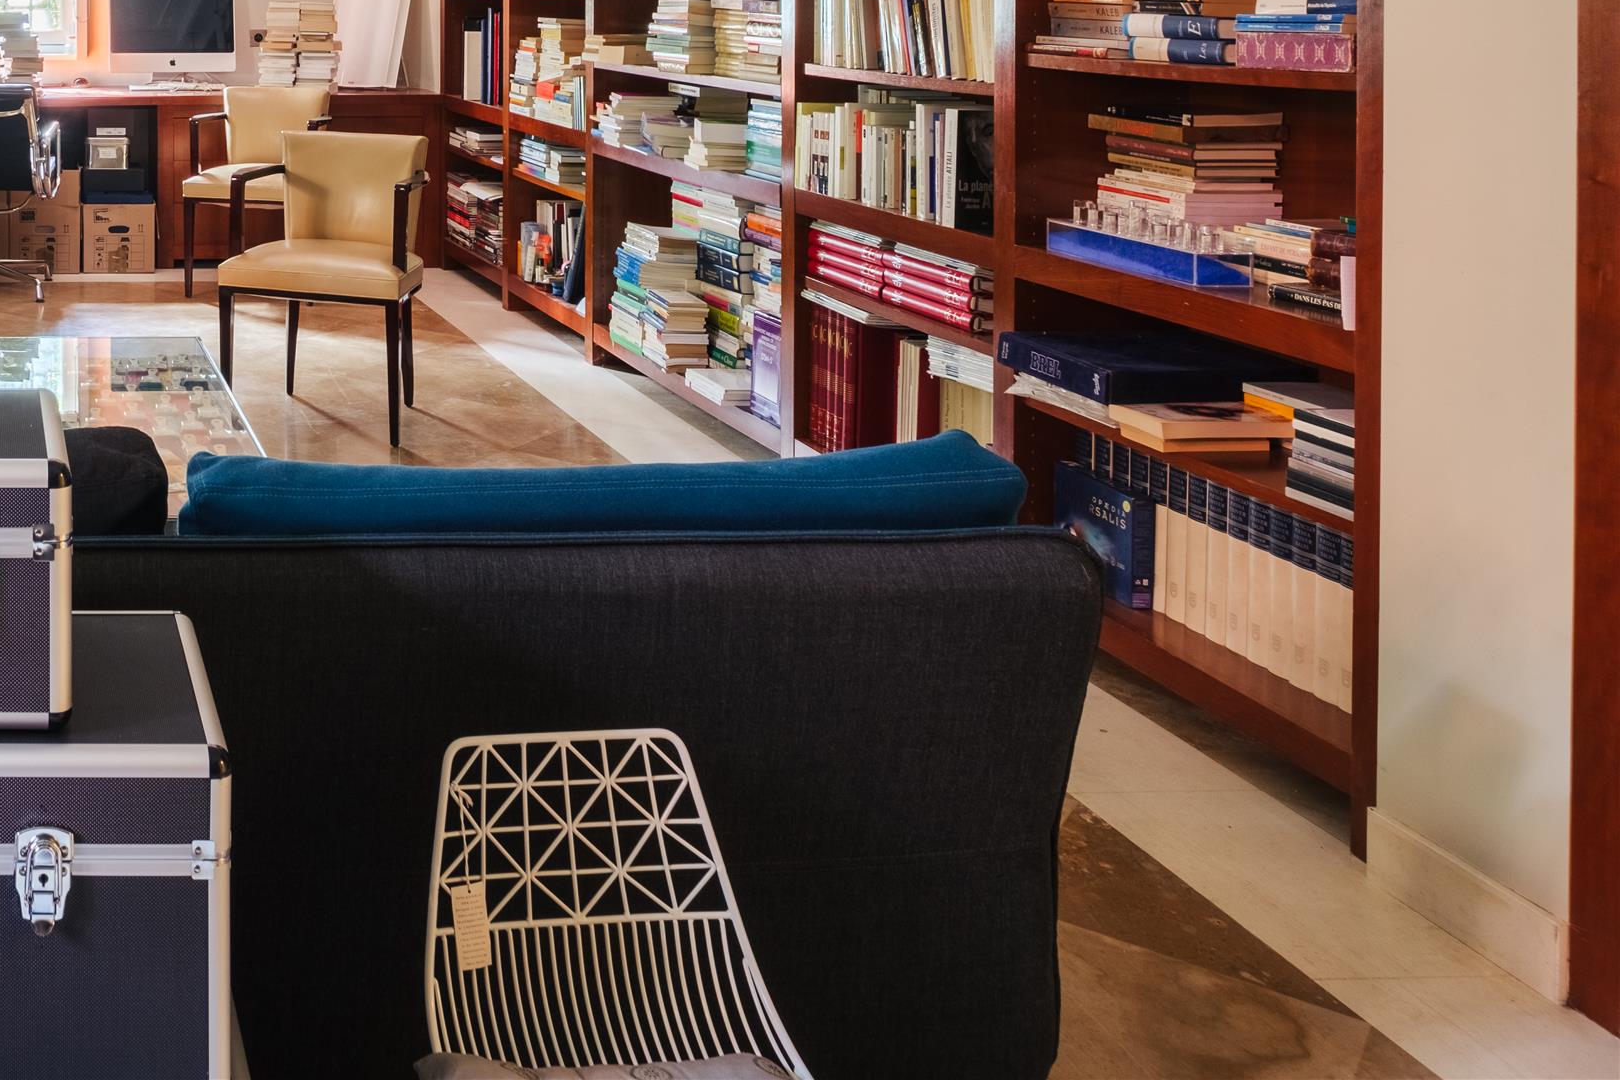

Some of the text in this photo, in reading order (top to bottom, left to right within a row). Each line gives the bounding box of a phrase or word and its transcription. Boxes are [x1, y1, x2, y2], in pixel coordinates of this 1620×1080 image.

[1096, 7, 1119, 17] KALEB
[959, 180, 968, 191] La
[1294, 293, 1309, 303] DANS
[1310, 296, 1321, 305] LES
[1322, 299, 1333, 308] PAS
[1030, 351, 1061, 379] BREL
